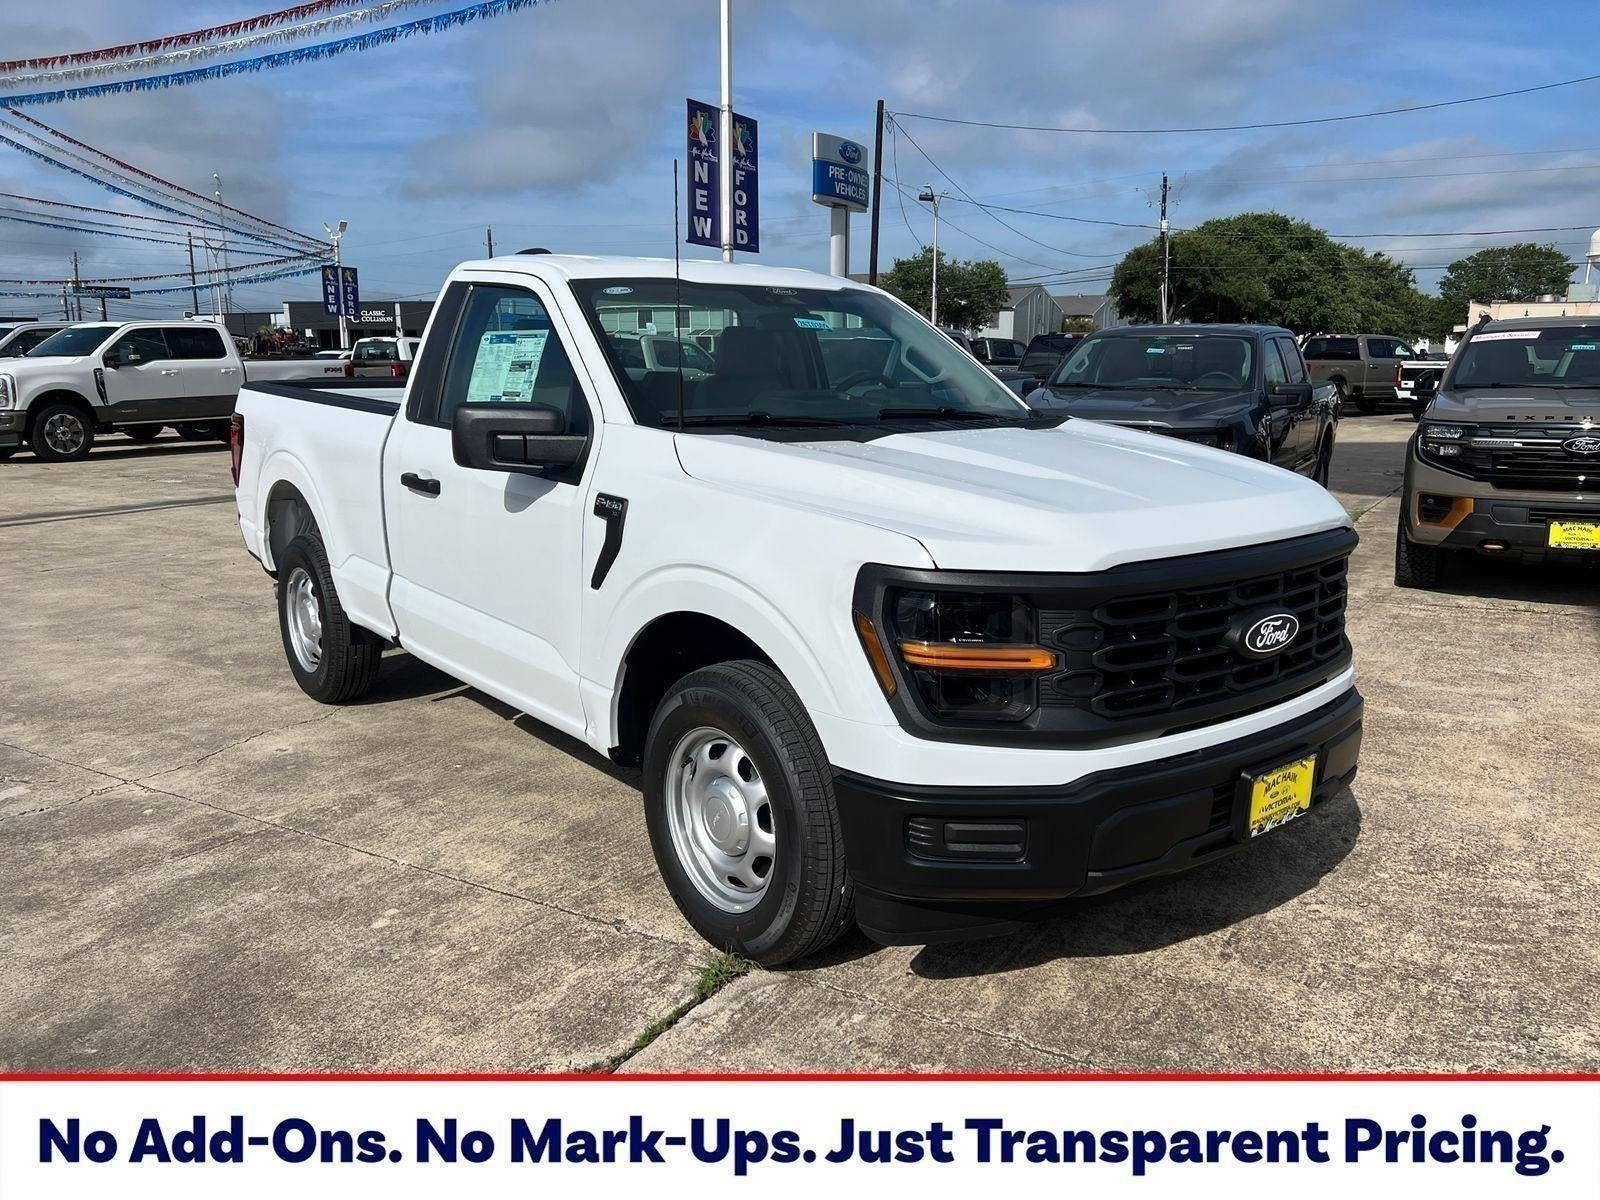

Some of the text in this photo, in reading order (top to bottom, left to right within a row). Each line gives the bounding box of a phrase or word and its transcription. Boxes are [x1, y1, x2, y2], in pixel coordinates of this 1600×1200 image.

[693, 160, 712, 239] NEW
[834, 181, 866, 200] VEHICLES
[734, 169, 749, 245] FORD
[327, 285, 337, 313] NEW
[346, 286, 355, 315] FORD
[1571, 439, 1600, 451] Ford
[1256, 619, 1290, 648] Ford
[1263, 774, 1281, 797] MAC
[1281, 770, 1298, 784] HAIK
[1264, 795, 1294, 813] VICTORIA
